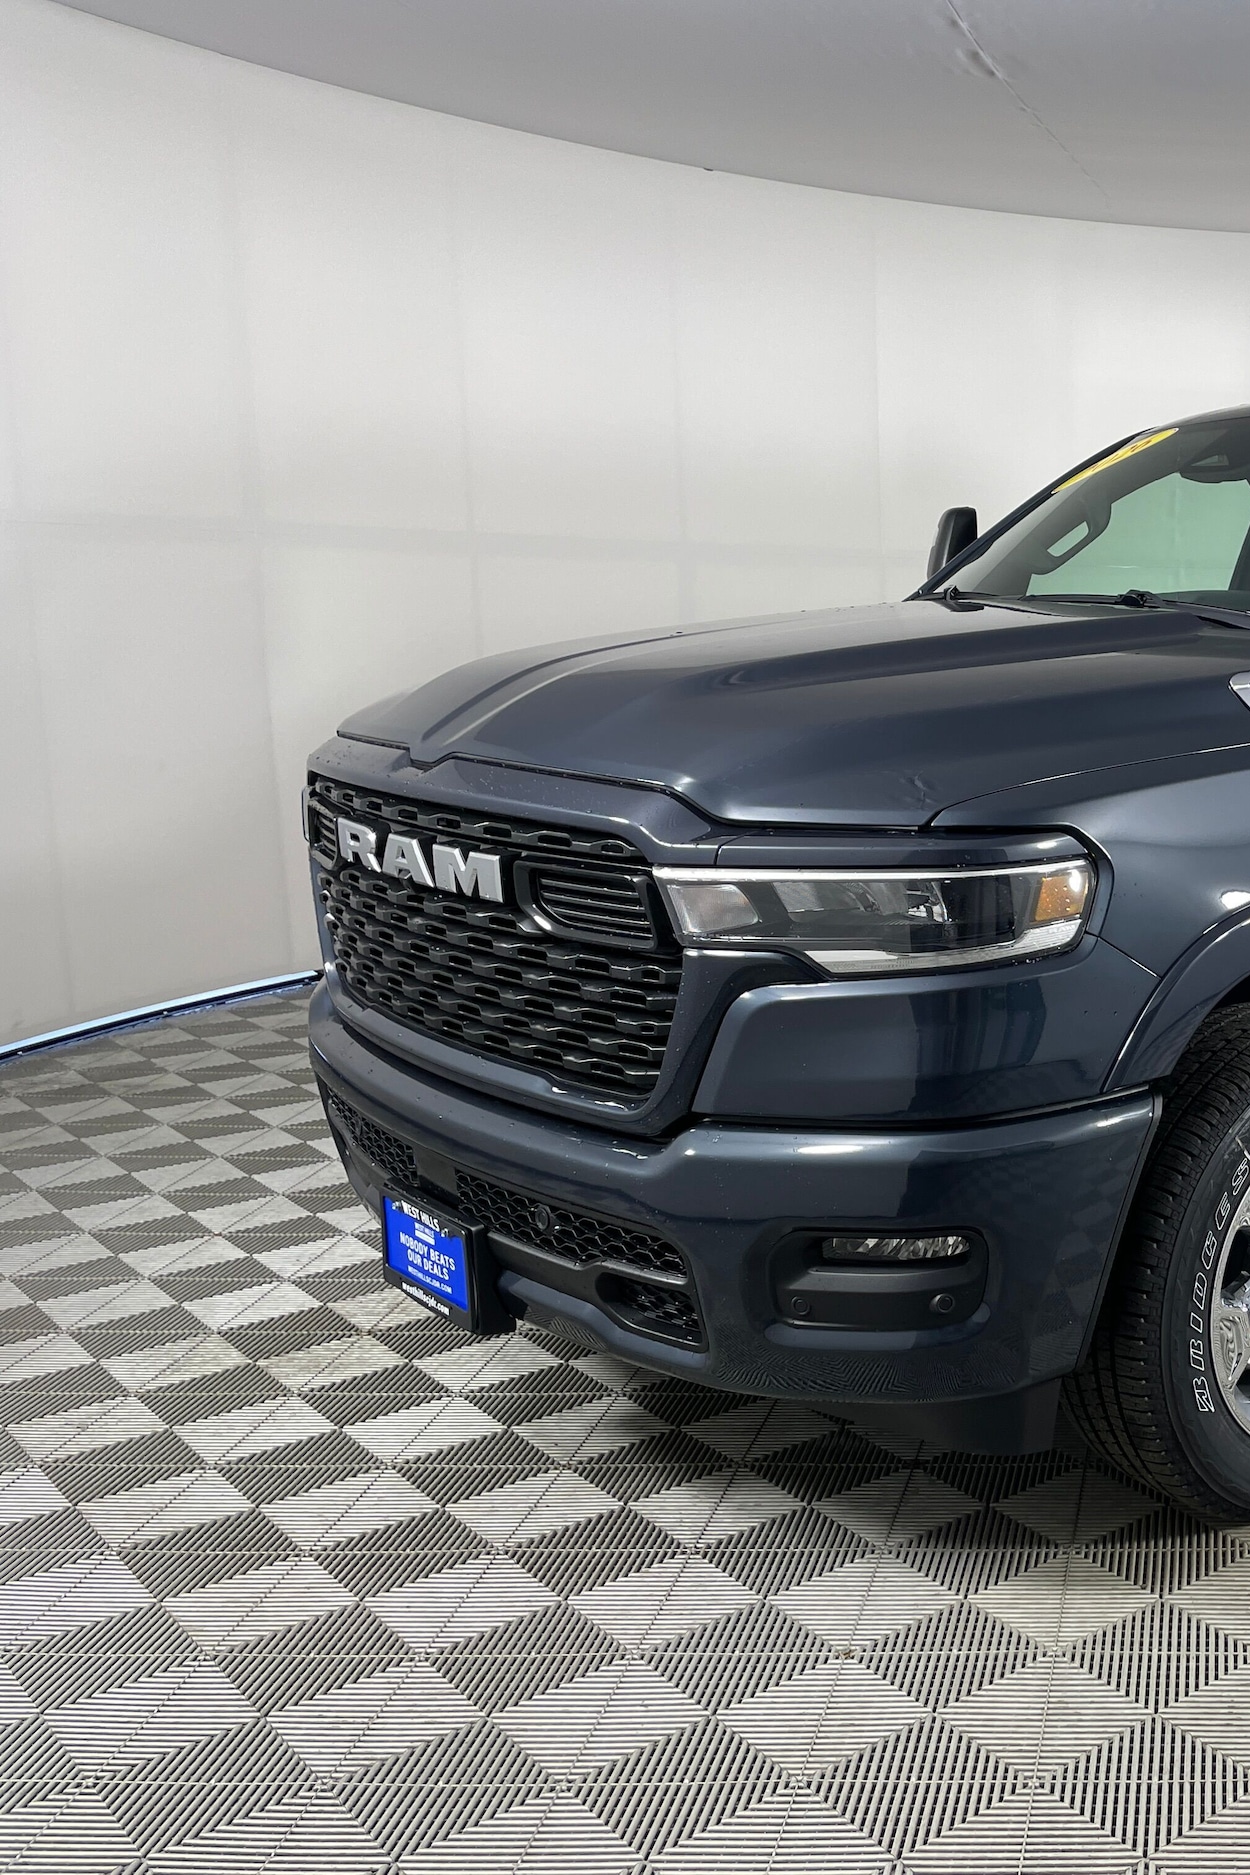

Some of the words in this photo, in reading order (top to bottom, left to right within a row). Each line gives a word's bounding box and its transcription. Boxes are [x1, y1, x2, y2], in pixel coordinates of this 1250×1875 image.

[337, 816, 504, 904] RAM
[401, 1200, 421, 1221] WEST
[420, 1211, 440, 1232] HILLS
[400, 1231, 429, 1257] NOBODY
[429, 1247, 456, 1271] BEATS
[407, 1249, 422, 1267] OUR
[423, 1257, 449, 1281] DEALS
[401, 1281, 450, 1316] westhillscjdr.com
